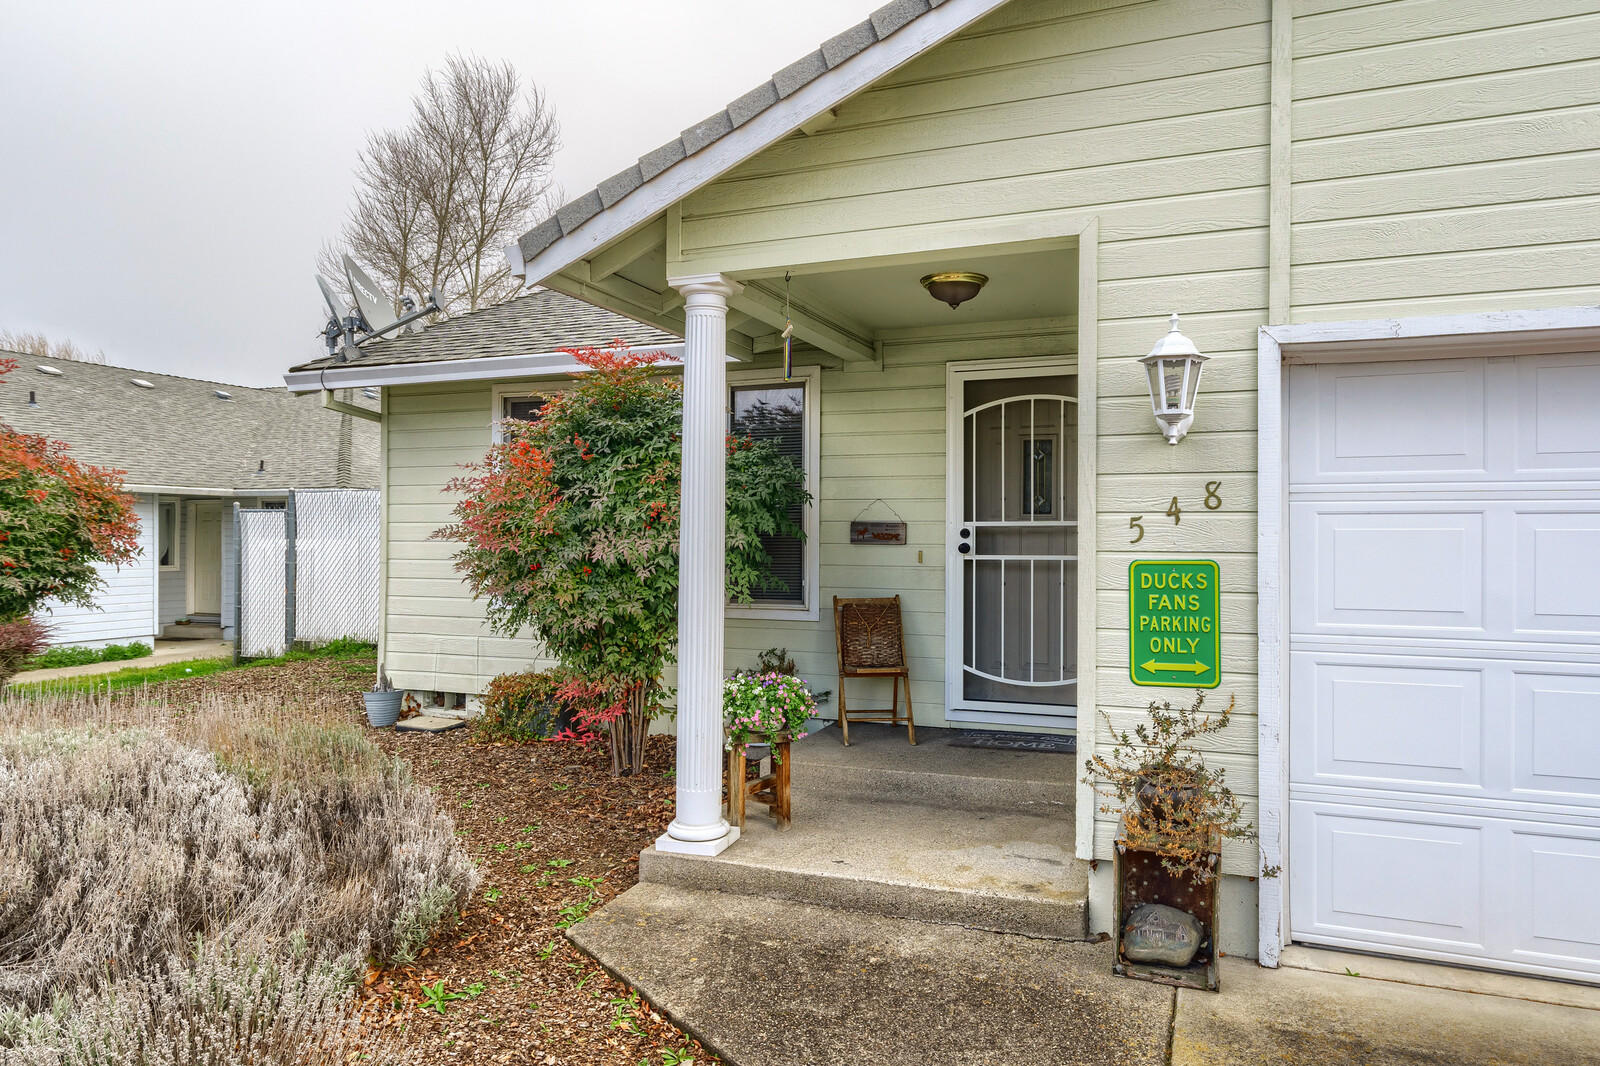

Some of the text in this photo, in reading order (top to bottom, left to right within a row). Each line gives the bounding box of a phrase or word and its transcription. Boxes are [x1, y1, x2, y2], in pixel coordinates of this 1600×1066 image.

[1141, 573, 1208, 590] DUCKS
[1148, 594, 1200, 611] FANS
[1139, 615, 1211, 633] PARKING
[1150, 637, 1200, 654] ONLY
